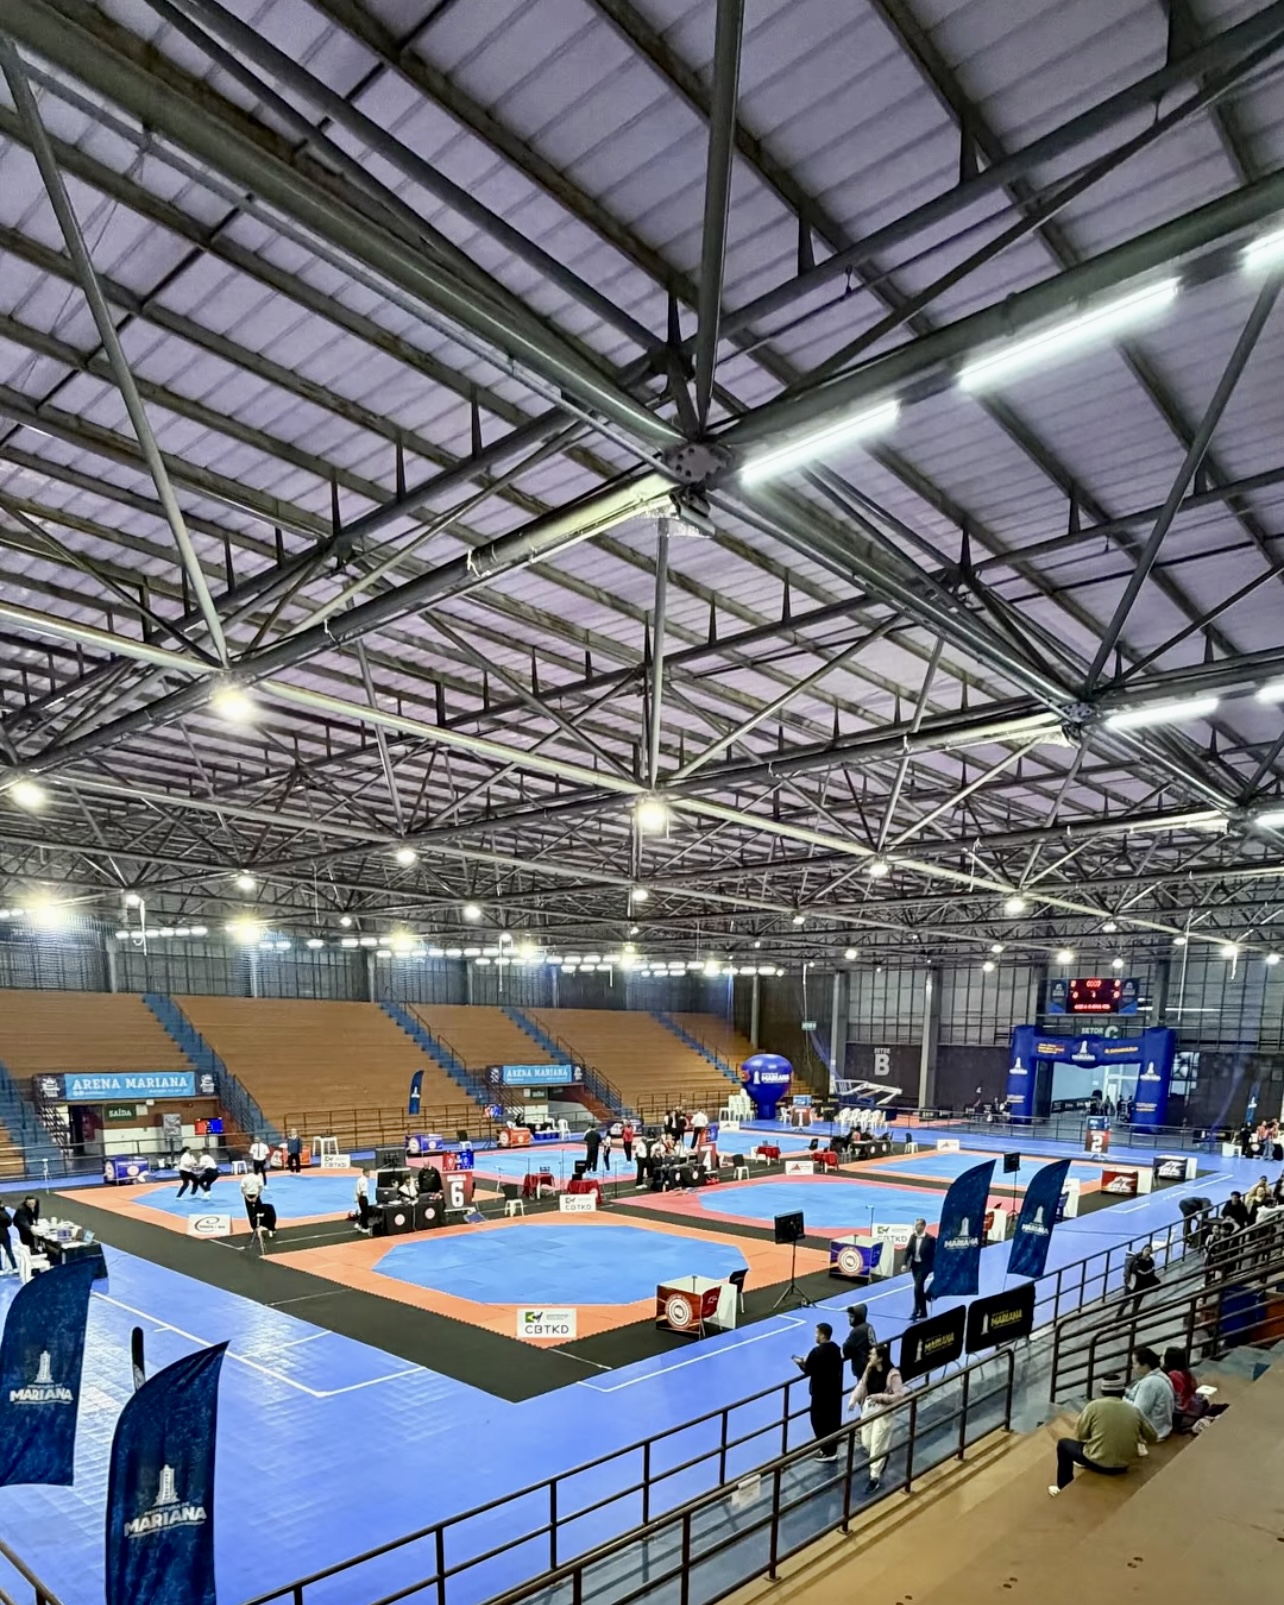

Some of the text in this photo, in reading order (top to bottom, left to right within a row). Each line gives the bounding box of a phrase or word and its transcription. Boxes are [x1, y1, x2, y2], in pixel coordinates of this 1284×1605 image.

[1104, 1025, 1119, 1039] C
[506, 1067, 568, 1078] ARENA MARIANA
[874, 1054, 890, 1076] B
[72, 1076, 188, 1091] ARENA MARIANA
[108, 1107, 132, 1118] SAÍDA
[1091, 1135, 1103, 1153] 2
[451, 1181, 464, 1207] 6
[524, 1324, 569, 1335] CBTKD
[9, 1387, 75, 1402] MARIANA
[123, 1506, 208, 1537] MARIANA
